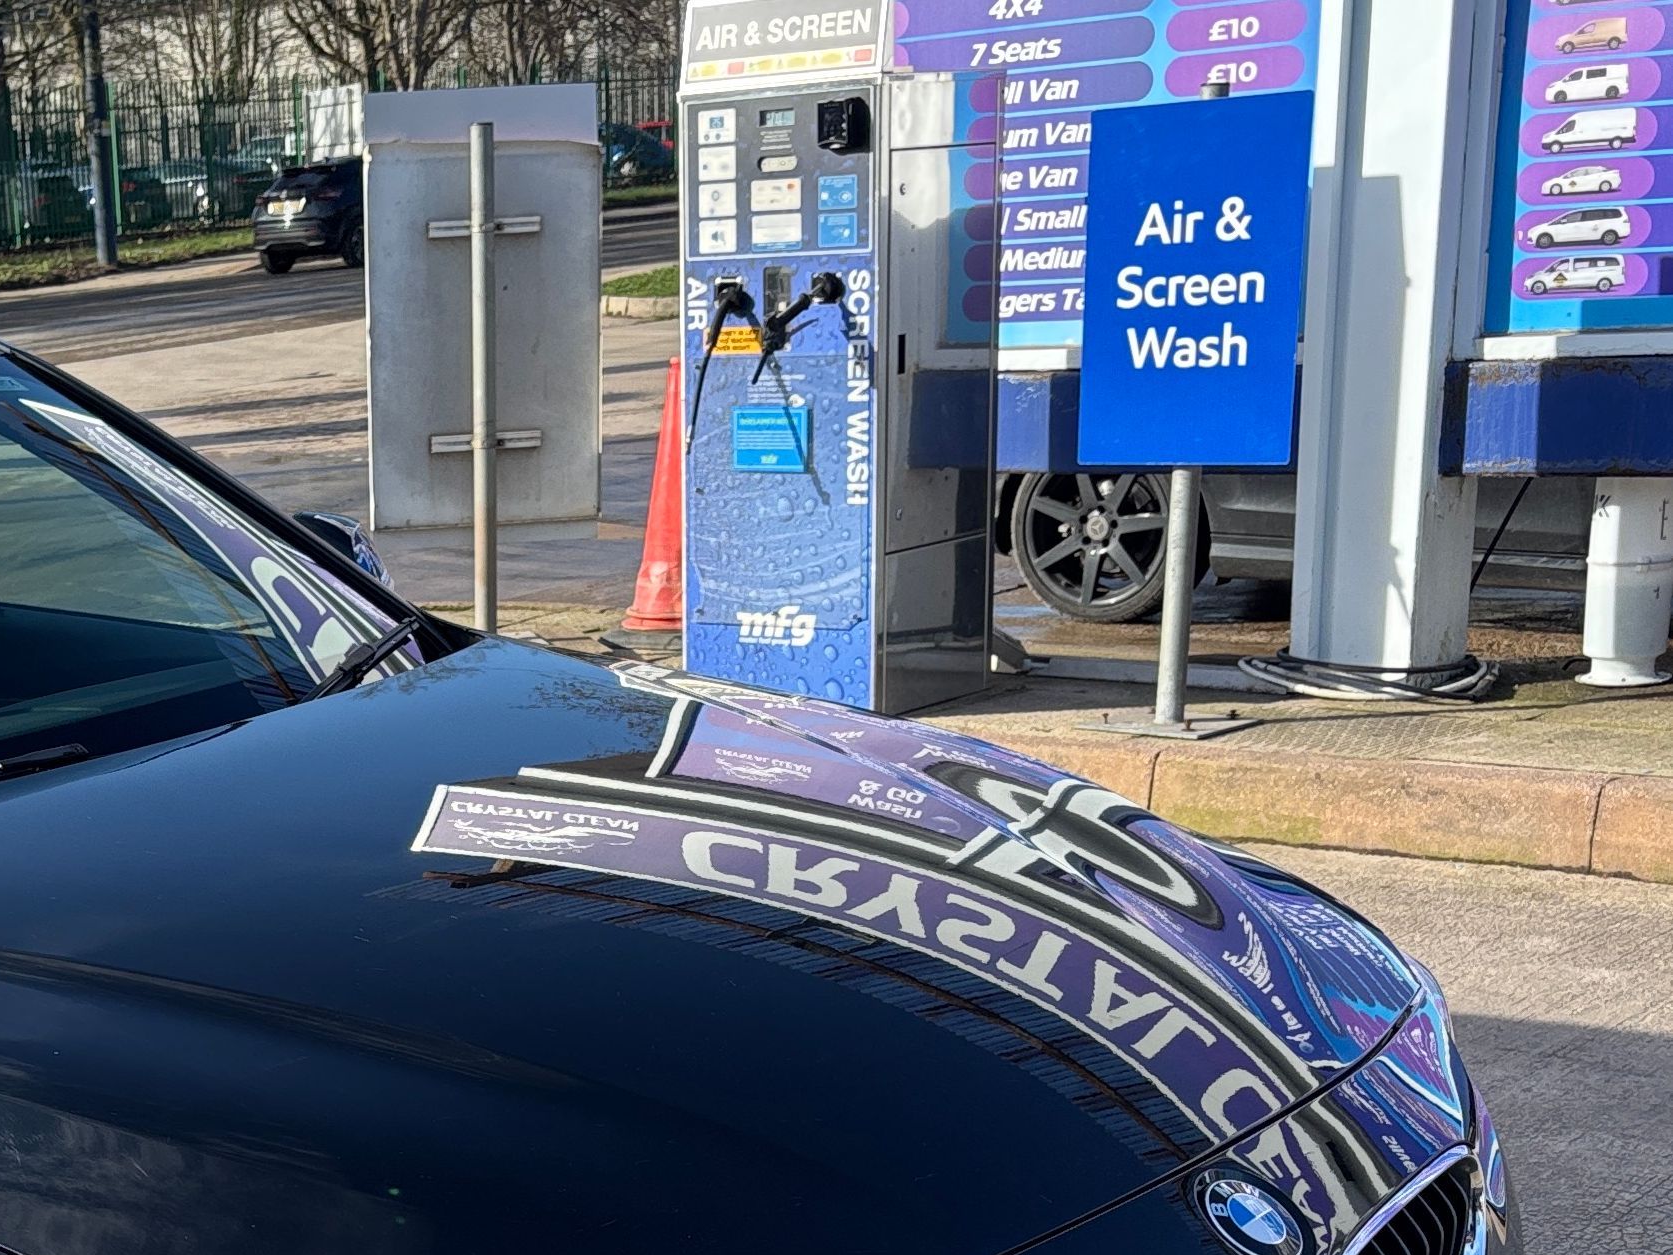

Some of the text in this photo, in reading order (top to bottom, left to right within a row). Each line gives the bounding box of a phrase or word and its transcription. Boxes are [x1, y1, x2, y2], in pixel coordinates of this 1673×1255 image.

[695, 7, 873, 51] AIR & SCREEN
[1208, 16, 1260, 41] £10
[969, 36, 1062, 66] 7 Seats
[1030, 78, 1079, 103] Van
[1207, 61, 1258, 84] £10
[1044, 121, 1092, 146] Van
[1028, 165, 1078, 190] Van
[1013, 204, 1088, 231] Small
[1134, 195, 1253, 247] Air &
[686, 276, 709, 331] AIR
[1115, 265, 1266, 310] Screen
[1125, 321, 1249, 369] Wash
[846, 268, 871, 507] SCREEN WASH
[736, 605, 817, 647] mfg
